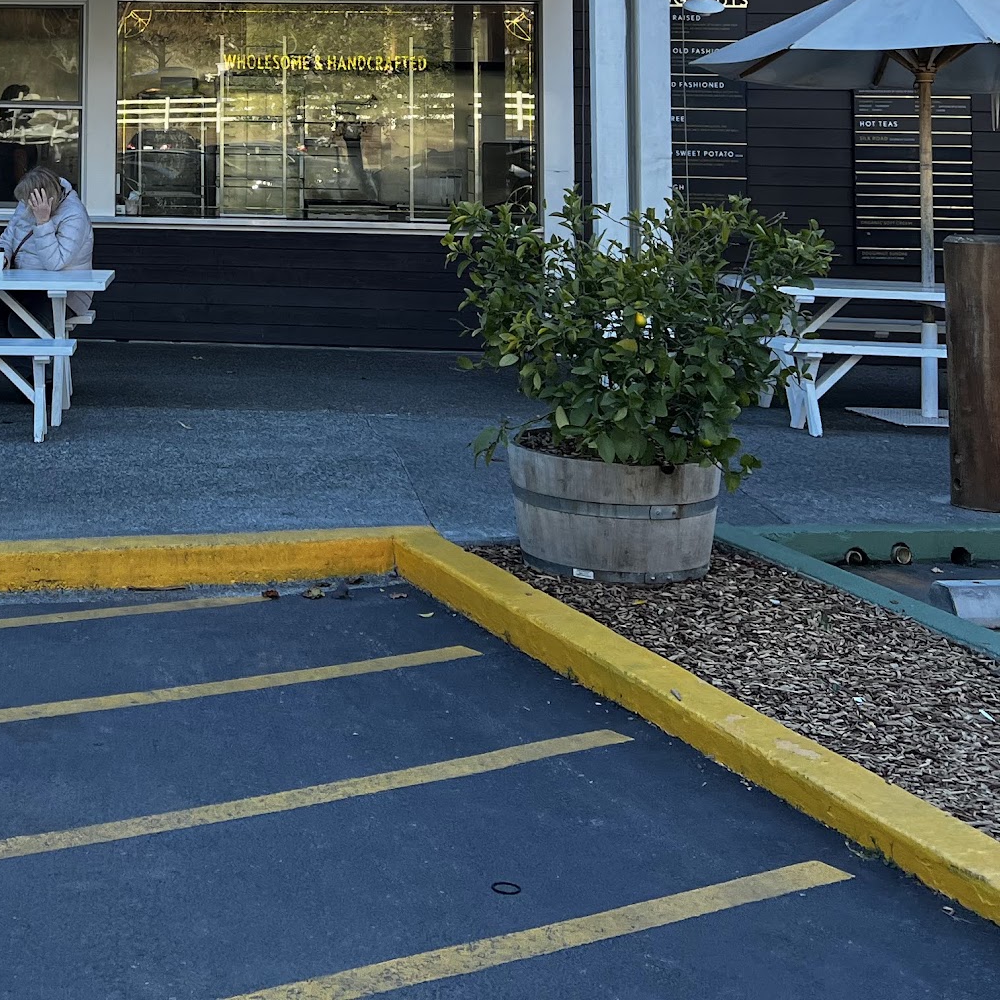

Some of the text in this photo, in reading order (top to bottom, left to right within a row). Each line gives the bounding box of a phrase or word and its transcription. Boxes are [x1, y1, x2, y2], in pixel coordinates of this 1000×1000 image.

[672, 14, 701, 22] RAISED
[223, 53, 427, 72] WHOLESOME & HANDCRAFTED
[859, 120, 898, 128] HOT TEAS
[703, 150, 734, 158] POTATO
